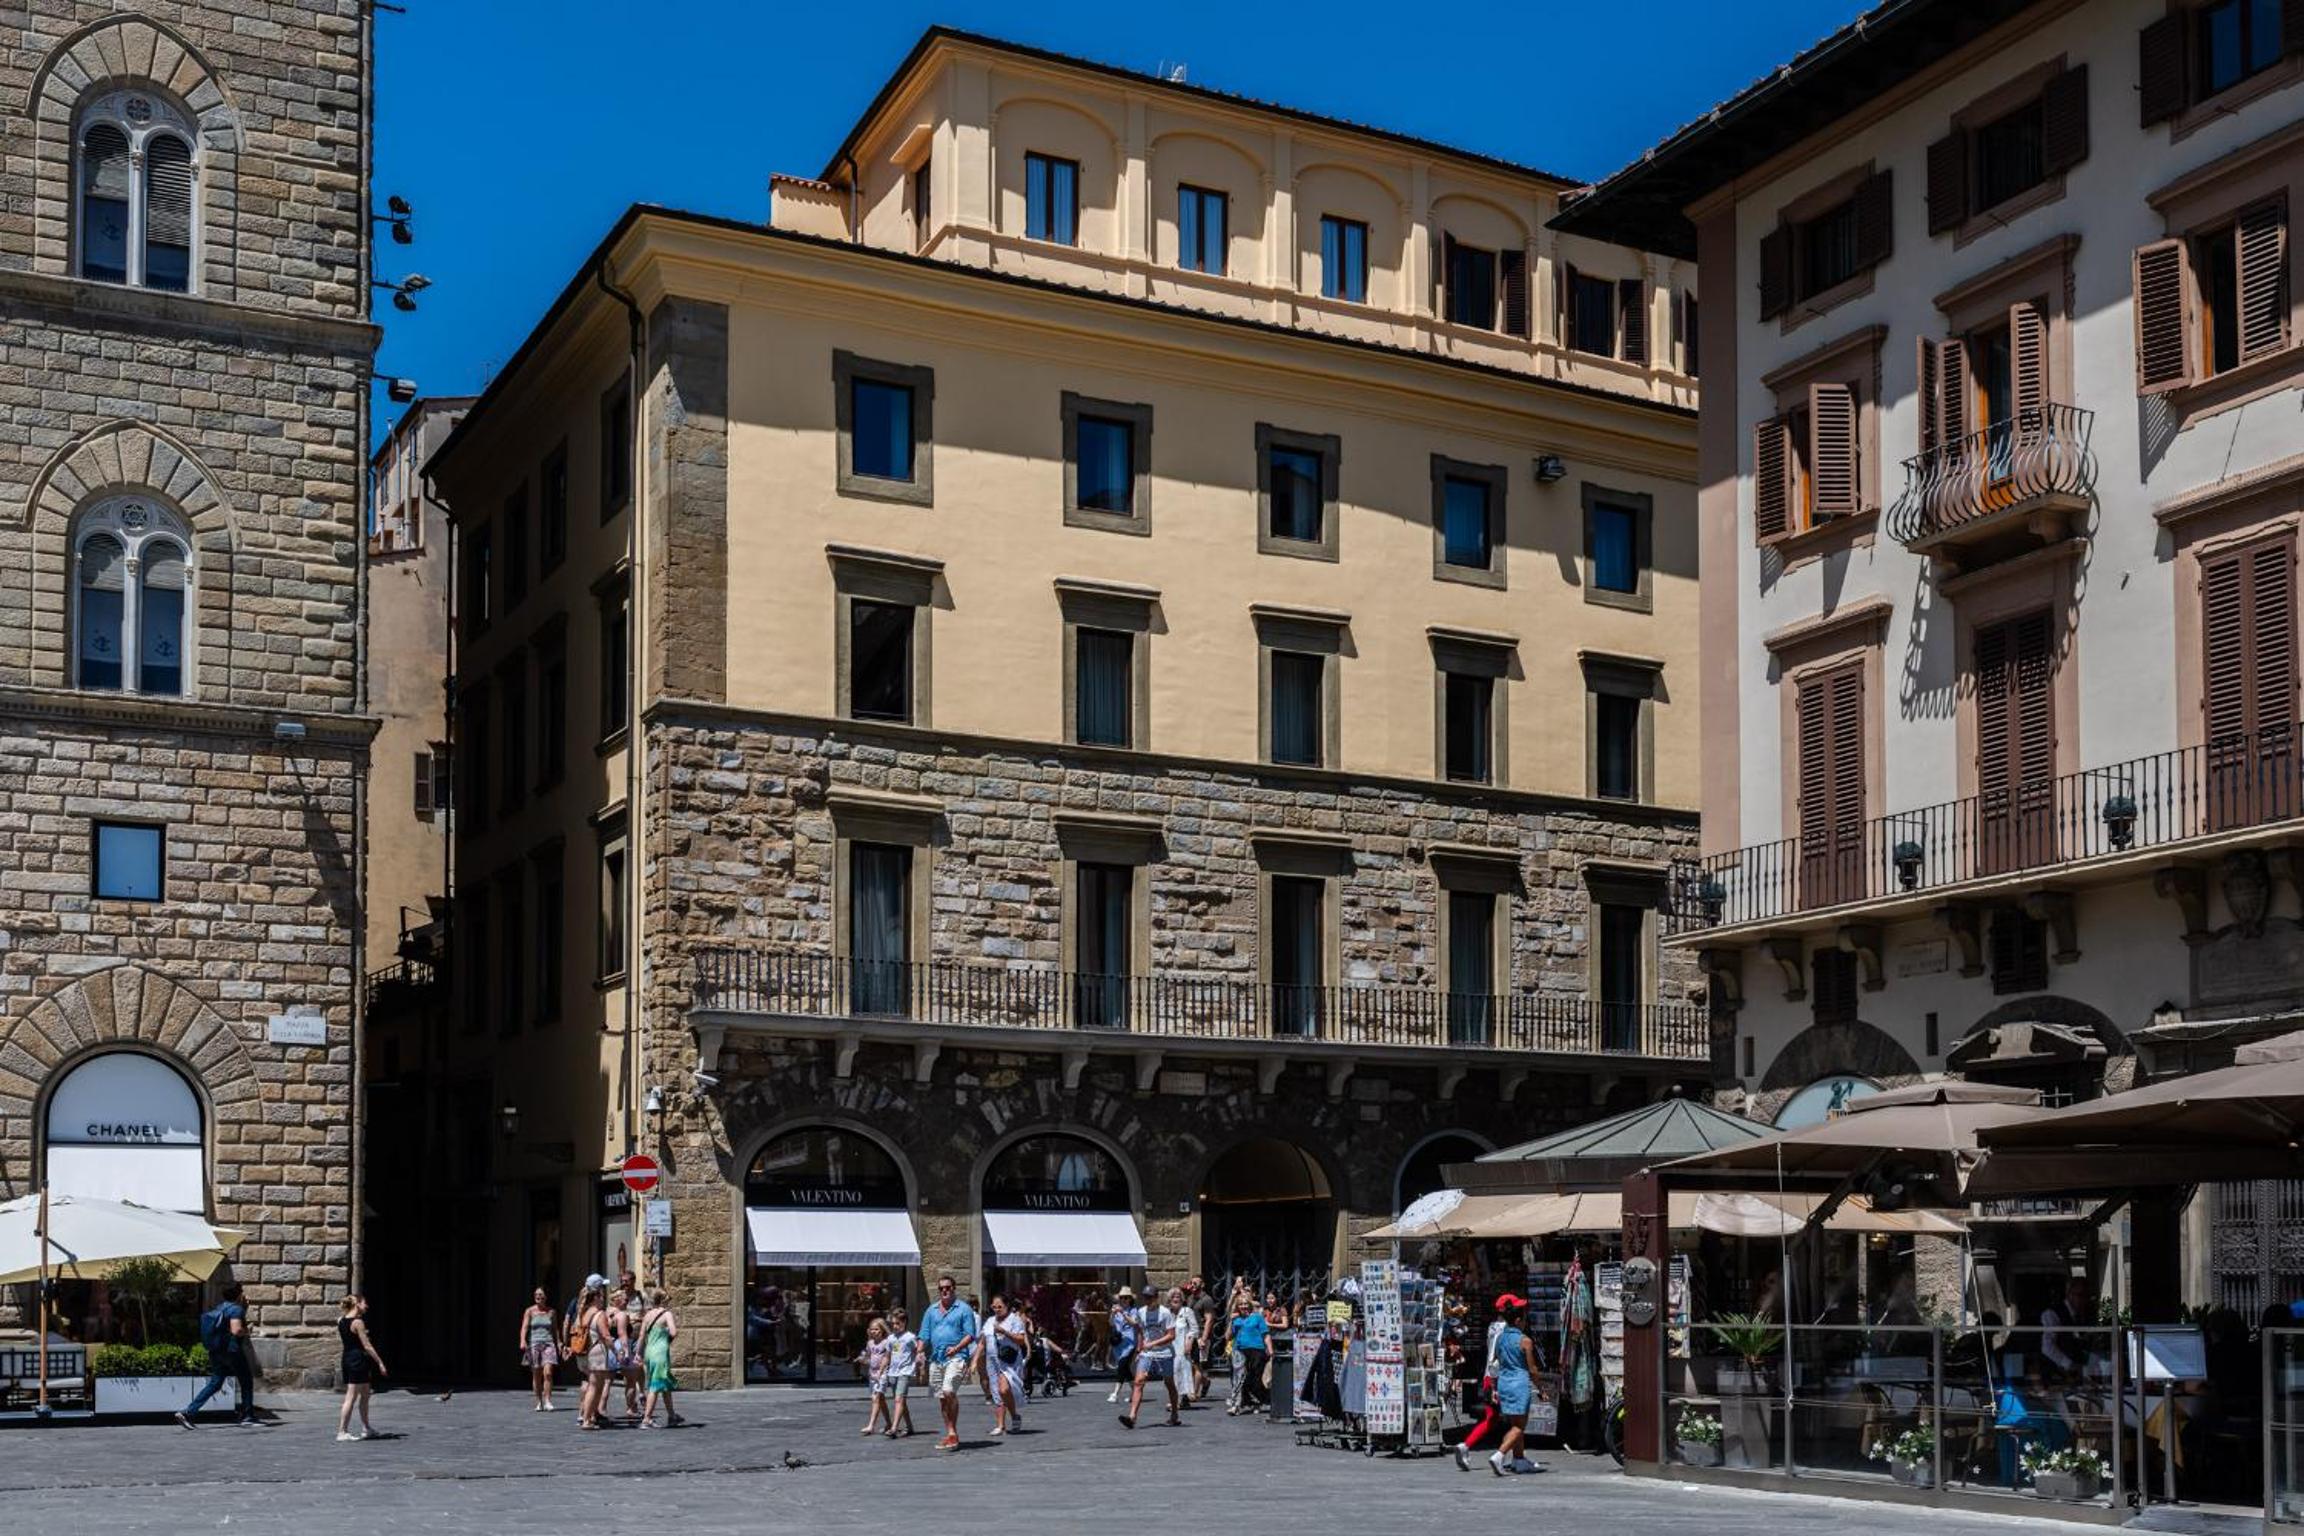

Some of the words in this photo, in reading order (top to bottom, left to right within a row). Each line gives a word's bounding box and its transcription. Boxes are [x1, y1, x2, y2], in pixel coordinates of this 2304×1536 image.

[86, 1124, 162, 1137] CHANEL
[790, 1189, 862, 1203] VALENTINO
[1024, 1194, 1090, 1208] VALENTINO
